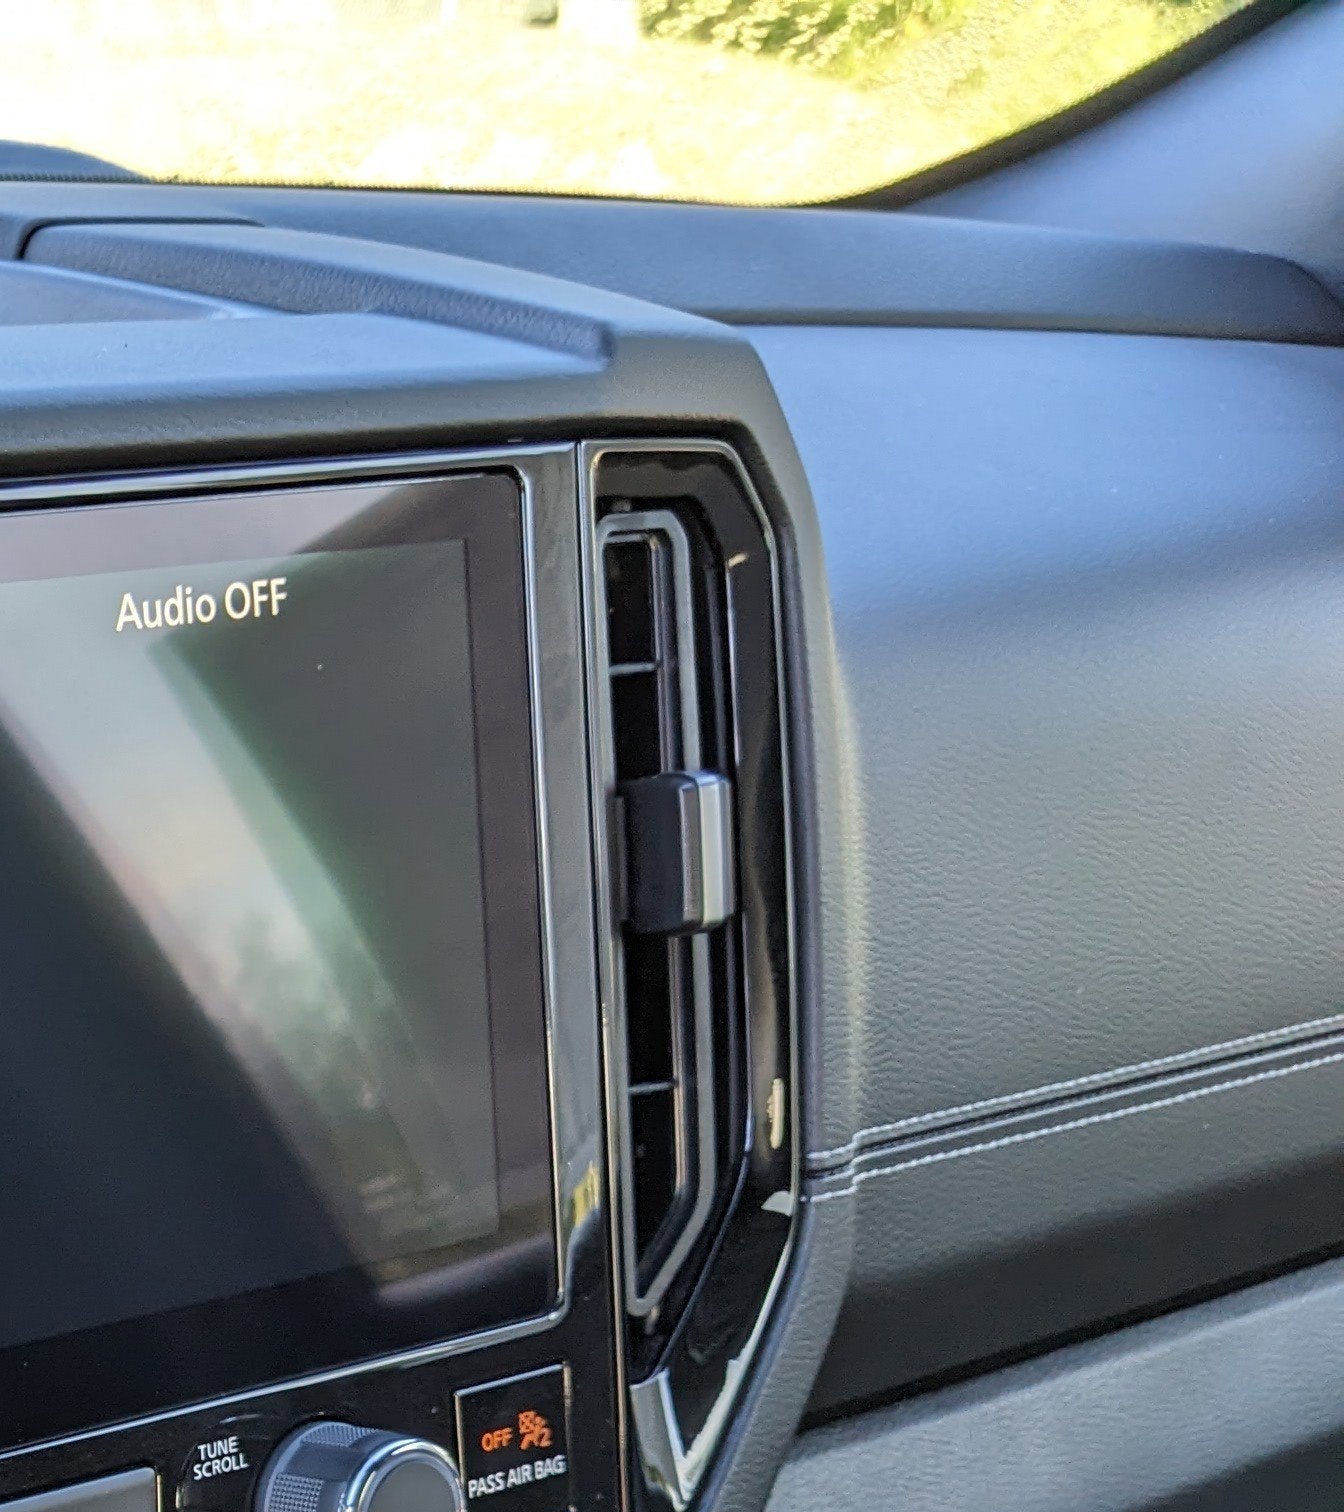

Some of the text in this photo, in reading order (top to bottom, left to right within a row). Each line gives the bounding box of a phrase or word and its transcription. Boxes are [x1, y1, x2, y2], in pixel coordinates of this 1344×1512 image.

[115, 578, 288, 633] Audio OFF
[197, 1435, 239, 1461] TUNE
[480, 1427, 513, 1453] OFF
[193, 1452, 249, 1481] SCROLL
[467, 1454, 567, 1499] PASS AIR BAG
